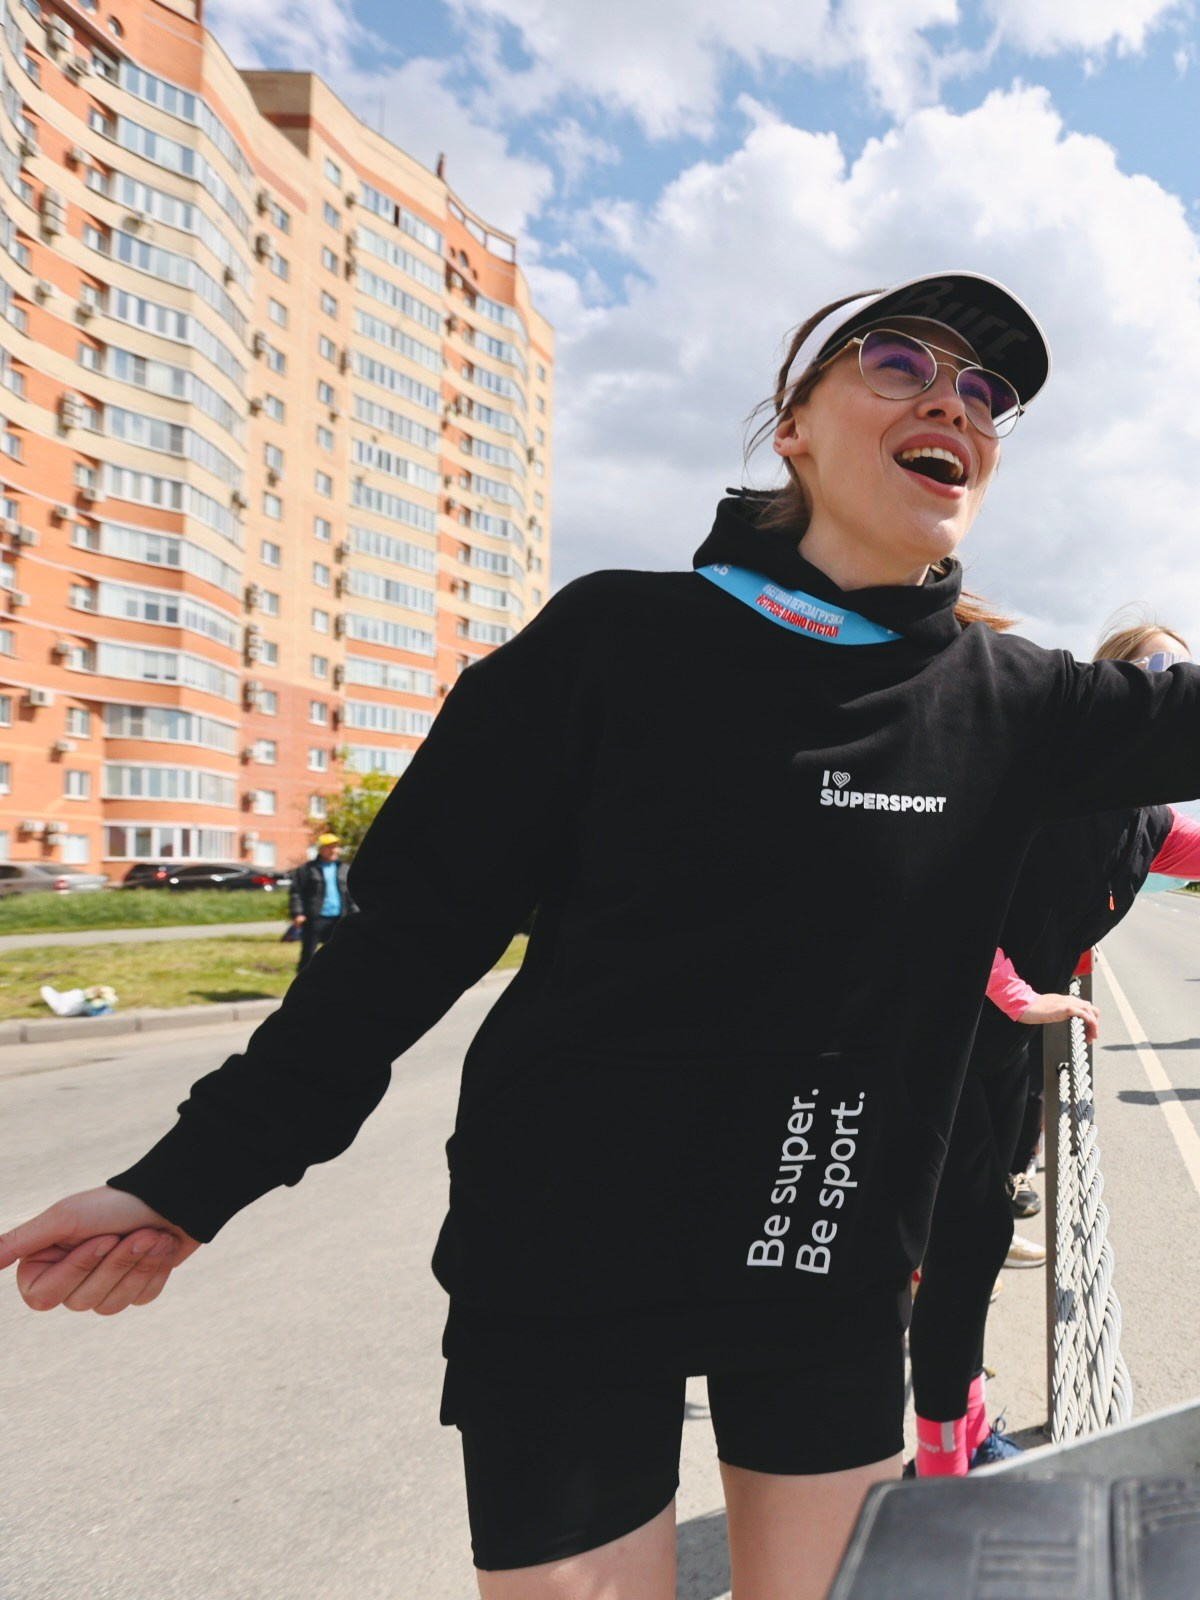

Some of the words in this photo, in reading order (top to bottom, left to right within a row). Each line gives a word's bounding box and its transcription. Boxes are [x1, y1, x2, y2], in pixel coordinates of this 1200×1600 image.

[781, 609, 808, 629] ДАВНО
[806, 620, 839, 638] ОТСТАЛ
[822, 770, 831, 788] I
[820, 788, 947, 813] SUPERSPORT
[746, 1214, 791, 1267] Be
[770, 1088, 820, 1205] super.
[795, 1219, 838, 1274] Be
[819, 1091, 866, 1209] sport.
